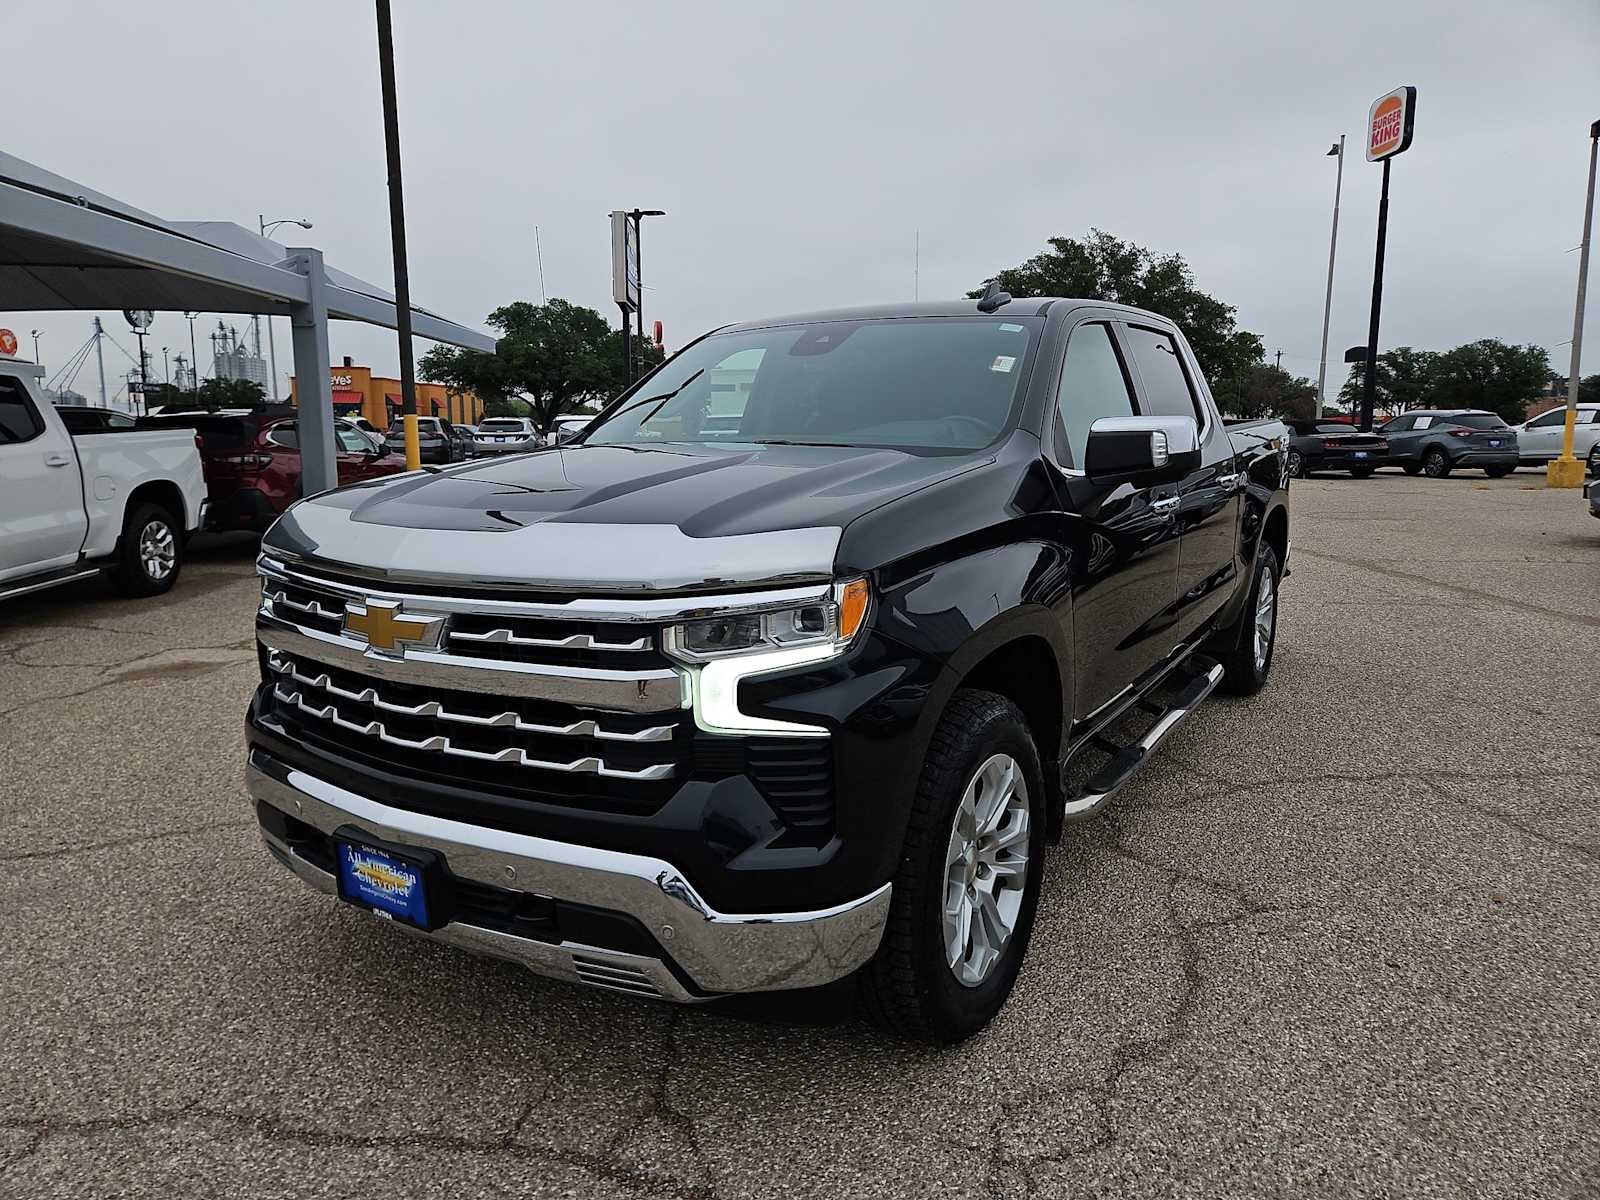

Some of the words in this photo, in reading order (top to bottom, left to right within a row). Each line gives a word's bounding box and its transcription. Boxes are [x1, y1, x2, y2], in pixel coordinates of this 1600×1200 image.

[1371, 121, 1400, 147] KING
[1373, 110, 1401, 131] BURGER
[347, 852, 362, 866] All
[365, 857, 417, 885] American
[357, 869, 410, 898] Chevrolet
